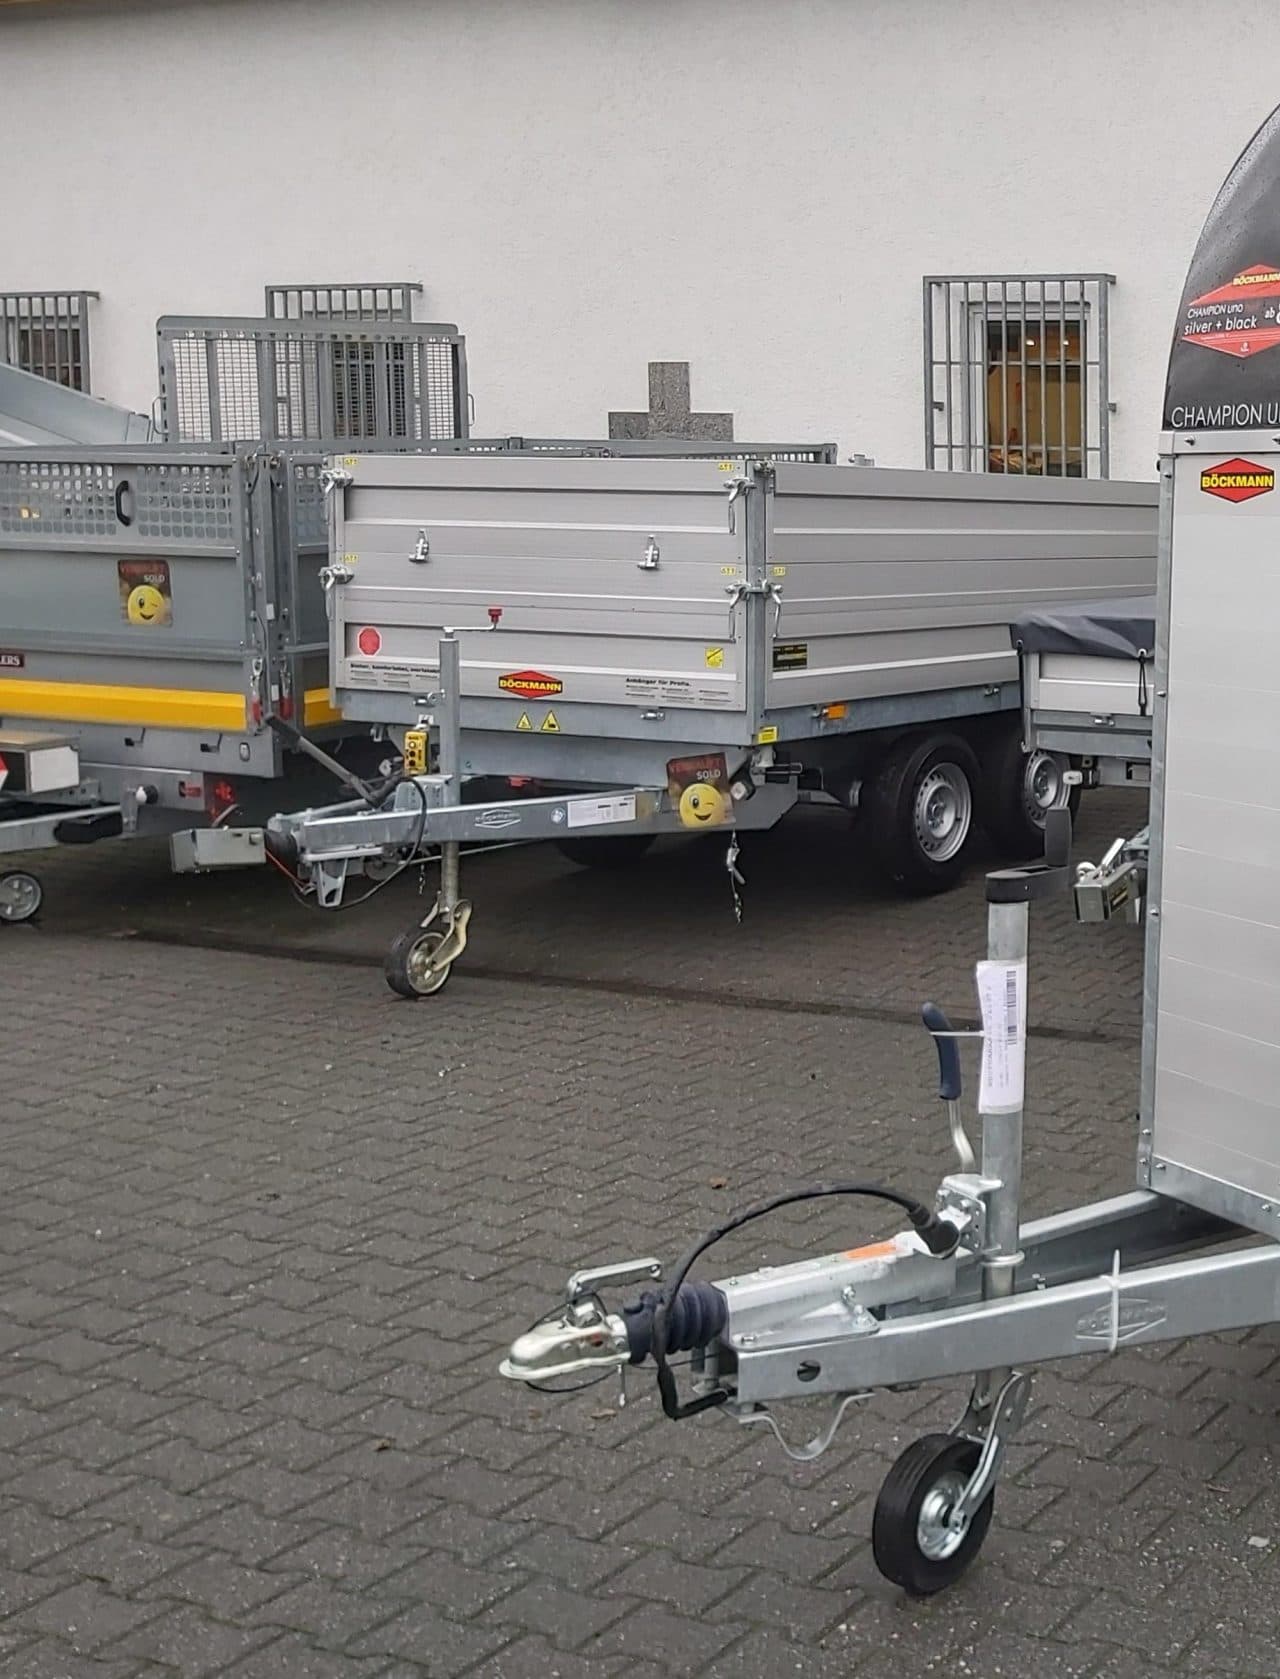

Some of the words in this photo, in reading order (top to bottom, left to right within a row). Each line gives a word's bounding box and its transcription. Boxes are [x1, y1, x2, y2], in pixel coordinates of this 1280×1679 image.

[1232, 272, 1280, 286] BÖCKMANN
[1187, 304, 1228, 319] CHAMPION
[1227, 303, 1244, 314] uno
[1264, 306, 1275, 319] ab
[1184, 320, 1213, 335] silver
[1225, 315, 1257, 331] black
[1171, 403, 1262, 428] CHAMPION
[1202, 473, 1274, 488] BÖCKMANN
[499, 678, 562, 691] BÖCKMANN
[695, 768, 721, 780] SOLD
